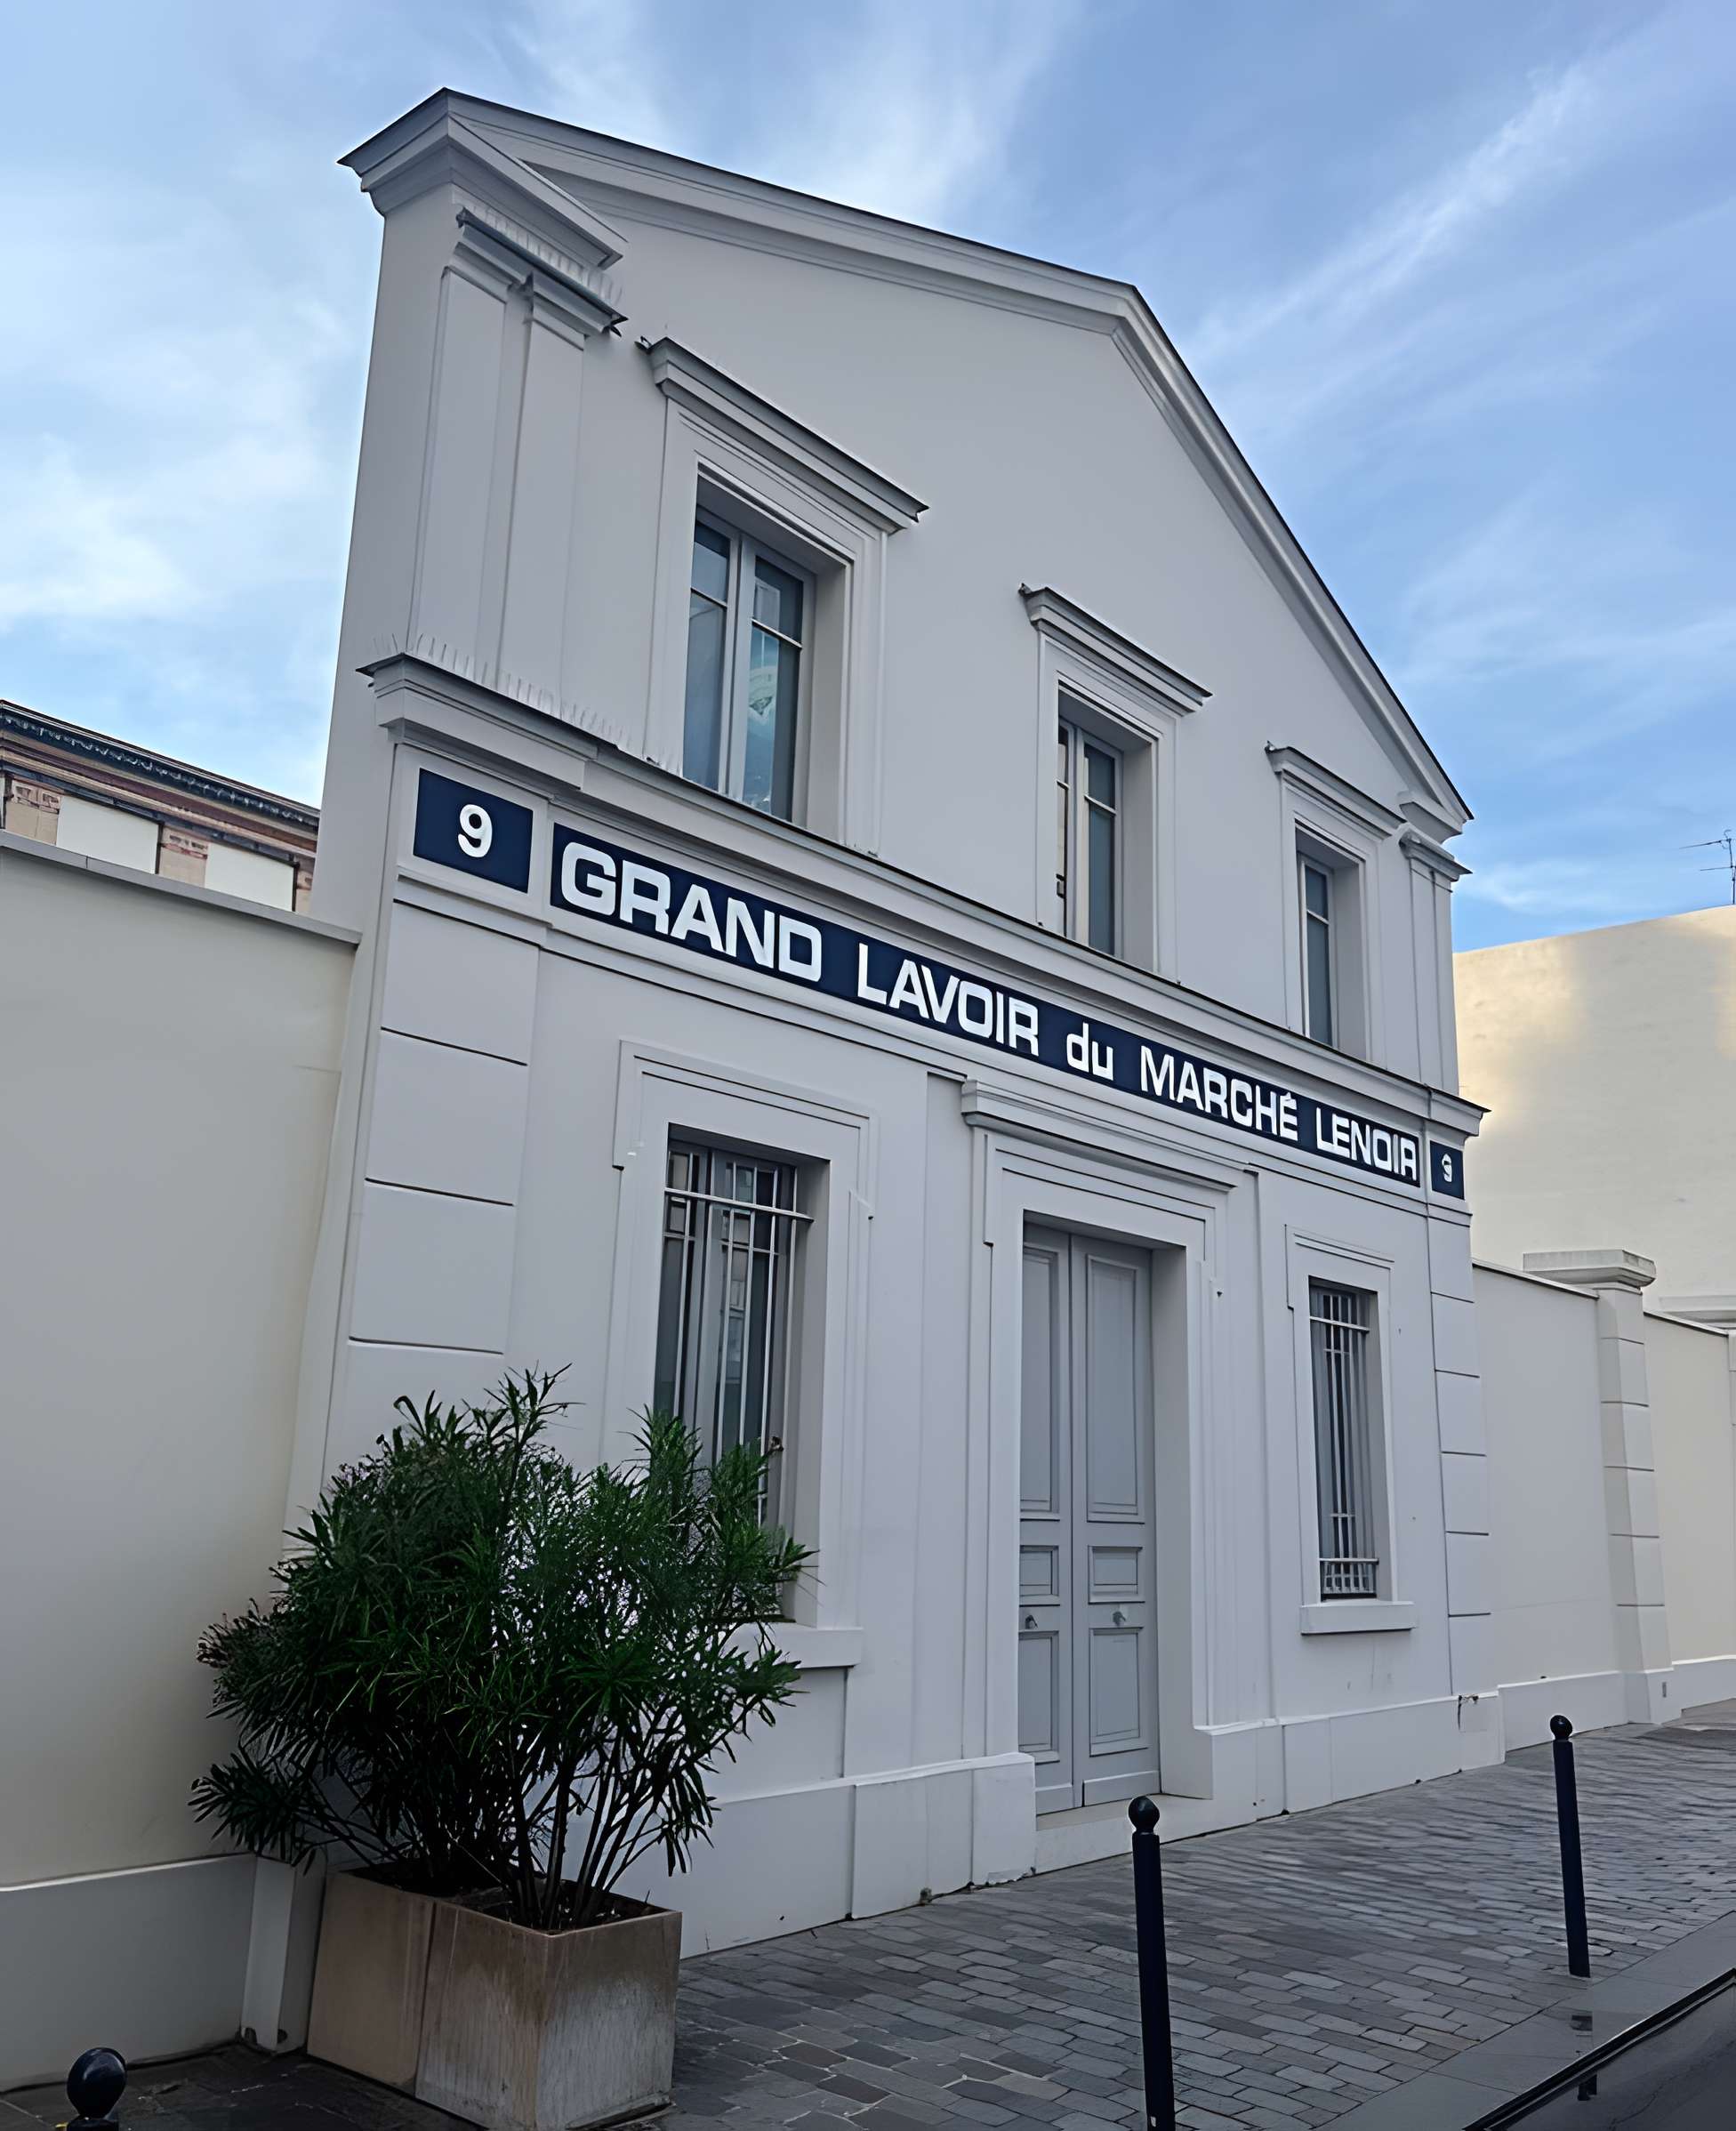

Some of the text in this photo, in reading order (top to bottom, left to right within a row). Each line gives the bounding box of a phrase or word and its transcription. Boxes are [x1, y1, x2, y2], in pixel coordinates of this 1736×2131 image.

[457, 803, 494, 858] 9
[560, 840, 1418, 1182] GRAND LAVOIR du MARCHÉ LENOIR
[1441, 1152, 1453, 1184] 9
